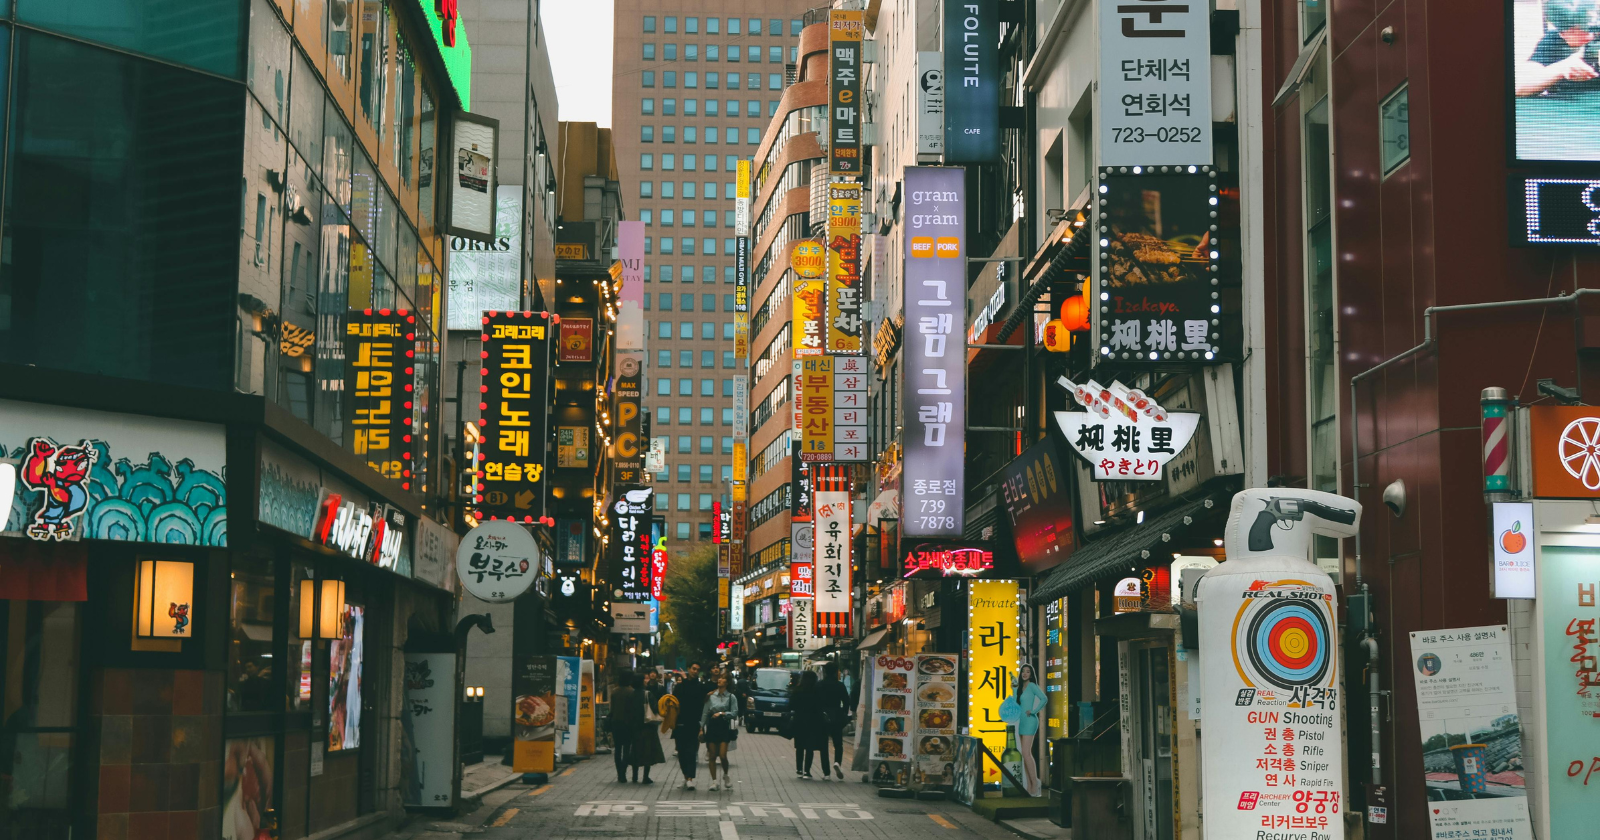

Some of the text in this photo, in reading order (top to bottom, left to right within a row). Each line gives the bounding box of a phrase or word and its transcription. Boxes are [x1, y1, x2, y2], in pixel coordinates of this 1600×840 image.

[833, 21, 860, 30] 최저가
[964, 4, 979, 88] FOLUITE
[1121, 58, 1190, 82] 단체석
[835, 48, 857, 143] 맥주e마트
[1121, 93, 1190, 116] 연회석
[1112, 127, 1201, 143] 723-0252
[912, 190, 958, 205] gram
[912, 213, 958, 228] gram
[913, 243, 957, 251] BEEF PORK
[622, 258, 641, 271] MJ
[492, 324, 545, 340] 고래고래
[805, 359, 830, 372] 대신
[917, 279, 953, 447] 그램그램
[499, 344, 532, 457] 코인노래
[805, 375, 830, 436] 부동산
[843, 377, 860, 458] 삼거리포차
[617, 402, 638, 458] PC
[809, 440, 826, 451] 1층
[485, 462, 543, 483] 연습장
[1099, 458, 1159, 476] やきとり
[620, 471, 633, 480] 3F
[913, 479, 956, 496] 종로점
[920, 500, 946, 514] 739
[468, 552, 523, 584] 부루스
[824, 521, 843, 599] 육회지존
[904, 550, 994, 570] 소갈비3종세트
[974, 597, 1016, 610] Private
[1242, 591, 1324, 600] REAL SHOT
[1422, 636, 1438, 644] 바로
[1456, 632, 1472, 642] 사용
[1474, 631, 1497, 640] 설명서
[1288, 687, 1337, 710] 사격장
[1247, 711, 1333, 728] GUN Shooting
[1298, 730, 1325, 741] Pistol
[1302, 746, 1324, 756] Rifle
[1256, 757, 1329, 773] 저격총 Sniper
[1300, 778, 1322, 787] Rapid
[1323, 779, 1334, 787] Fire
[1242, 792, 1257, 800] 프리
[1292, 790, 1340, 814] 양궁장
[1261, 815, 1329, 830] 리커브보우
[1256, 830, 1331, 840] Recurve Bow
[1435, 827, 1514, 839] #바로주스 먹고 힘내서
